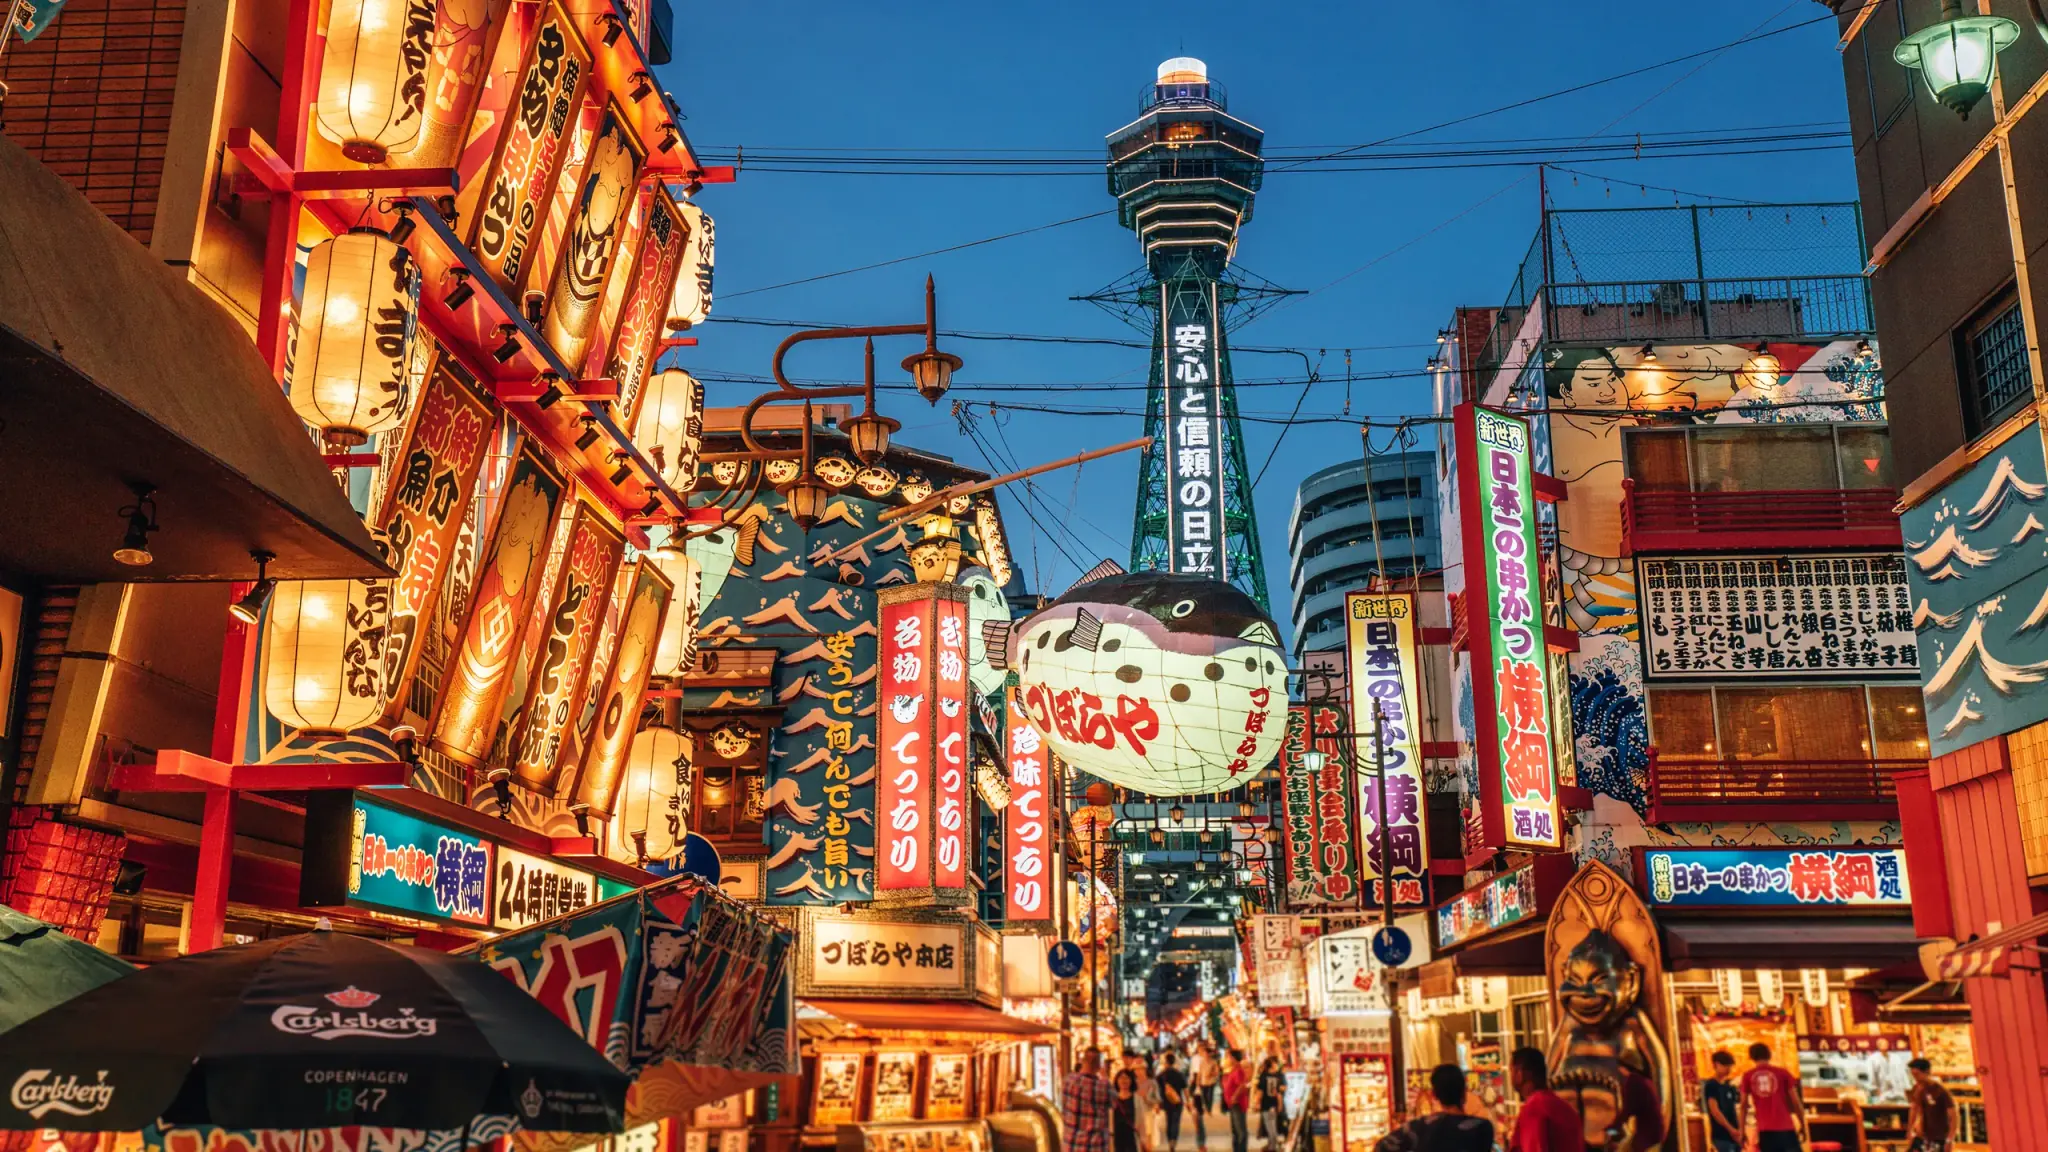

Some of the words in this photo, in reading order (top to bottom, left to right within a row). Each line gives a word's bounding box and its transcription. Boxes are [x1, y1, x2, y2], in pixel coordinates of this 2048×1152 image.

[482, 22, 564, 256] 名物串かつ
[420, 385, 482, 473] 新鮮
[1174, 324, 1215, 576] 安心と信頼の日立
[1479, 415, 1524, 452] 新世界
[401, 454, 459, 524] 魚介
[572, 526, 599, 577] 名物
[1491, 449, 1532, 655] 日本一の串かつ
[1647, 563, 1665, 589] 前頭
[1684, 562, 1702, 588] 前頭
[1702, 562, 1721, 588] 前頭
[1721, 561, 1739, 588] 前頭
[1739, 561, 1758, 588] 前頭
[1757, 561, 1777, 587] 前頭
[1795, 560, 1814, 587] 前頭
[1814, 560, 1832, 586] 前頭
[1832, 560, 1851, 586] 前頭
[1851, 559, 1870, 585] 前頭
[1870, 559, 1889, 585] 前頭
[1353, 598, 1408, 618] 新世界
[545, 545, 612, 772] 大阪下町の味
[893, 616, 921, 683] 名物
[939, 615, 962, 682] 名物
[1652, 615, 1671, 670] もち
[1671, 614, 1691, 669] うずら玉子
[1688, 614, 1710, 669] 紅しょうが
[1707, 615, 1727, 669] にんにく
[1726, 614, 1747, 669] 玉ねぎ
[1744, 614, 1766, 669] 山芋
[1764, 614, 1785, 668] しし唐
[1782, 613, 1804, 668] れんこん
[1800, 612, 1822, 667] 銀杏
[1820, 612, 1841, 667] 白ねぎ
[1839, 612, 1860, 667] さつま芋
[1857, 611, 1879, 667] じゃが芋
[1876, 611, 1898, 666] 茄子
[1895, 611, 1917, 666] 椎茸
[1026, 682, 1160, 756] づぼらや
[1365, 622, 1407, 769] 日本一の串かつ
[1227, 685, 1272, 776] づぼらや
[1498, 659, 1550, 801] 横綱
[822, 630, 856, 890] 安うて何んでも旨い
[890, 731, 920, 872] てっちり
[938, 732, 962, 872] てっちり
[1012, 724, 1044, 912] 珍味てっちり
[1364, 774, 1423, 876] 横綱
[1514, 808, 1553, 838] 酒処
[363, 834, 434, 888] 日本一の串かつ
[435, 836, 488, 917] 横綱
[500, 861, 588, 924] 24時間営業
[1652, 855, 1673, 900] 新世界
[1672, 866, 1787, 893] 日本一の串かつ
[1788, 853, 1876, 901] 横綱
[1876, 855, 1902, 899] 酒処
[821, 938, 955, 970] づぼらや本店
[271, 1005, 437, 1040] Carlsberg
[11, 1068, 116, 1120] Carlsberg
[304, 1069, 408, 1085] COPENHAGEN
[325, 1087, 388, 1113] 1847
